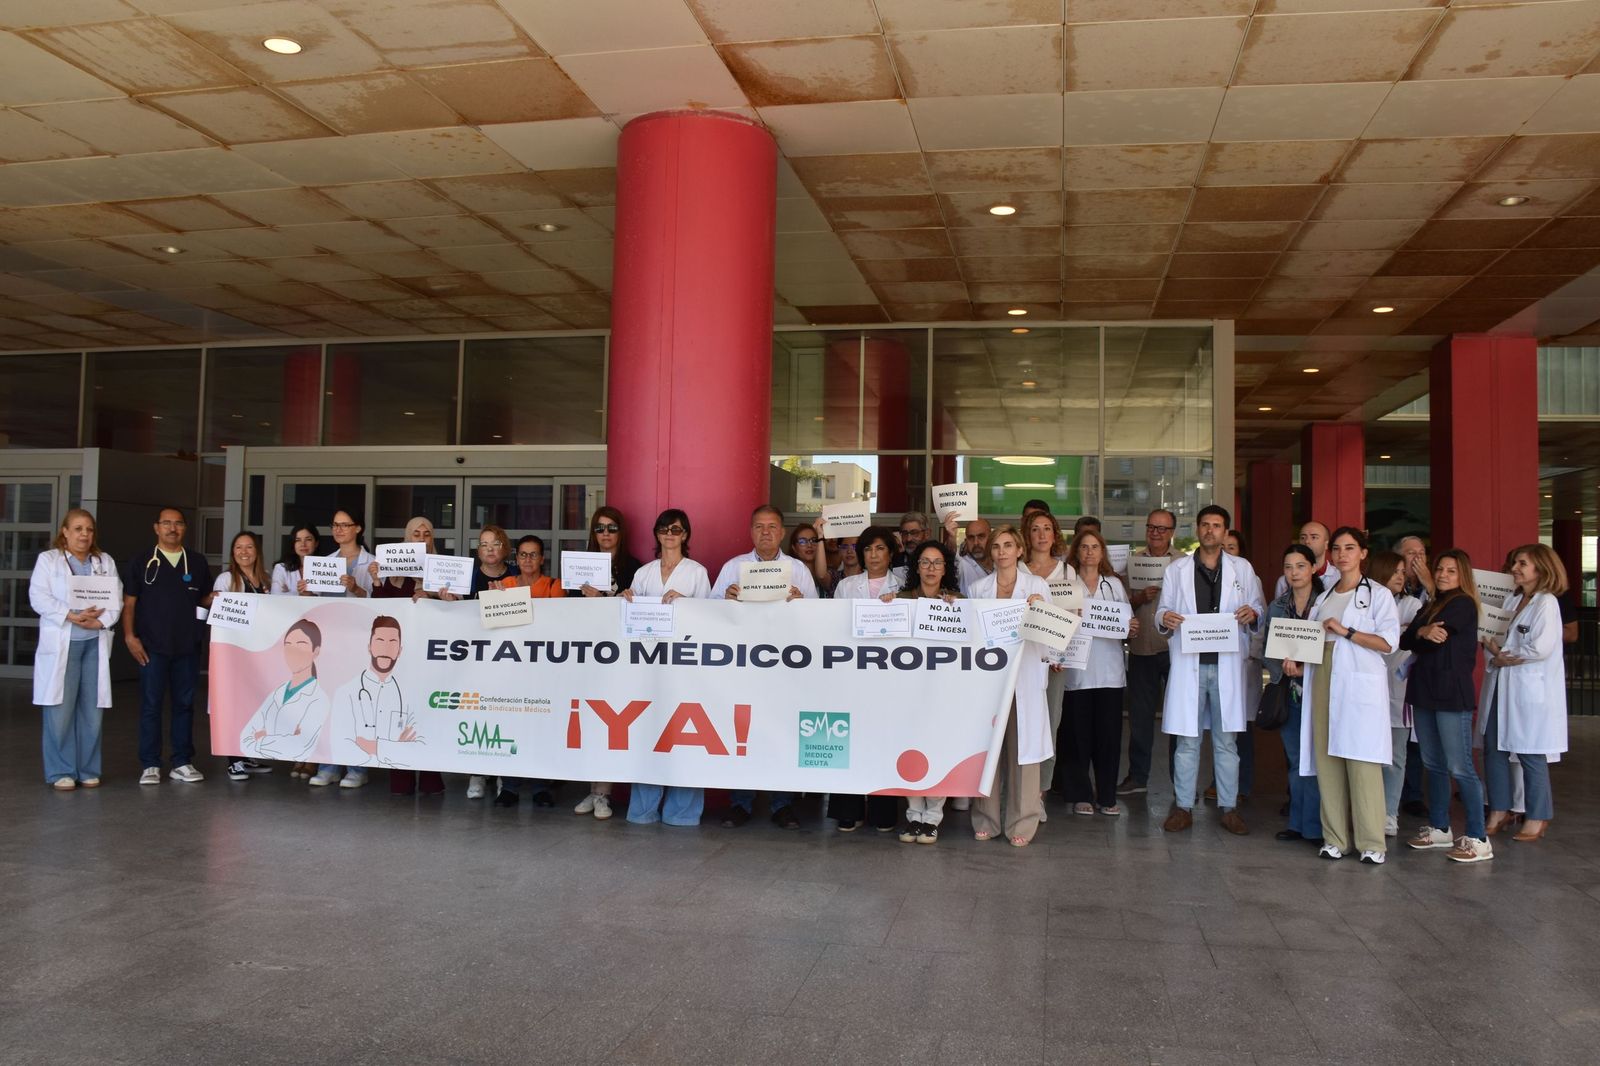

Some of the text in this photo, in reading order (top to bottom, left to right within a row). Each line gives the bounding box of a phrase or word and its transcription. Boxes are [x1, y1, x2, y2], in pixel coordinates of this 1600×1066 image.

[221, 606, 246, 615] TIRANÍA
[1004, 608, 1026, 616] QUIERO
[226, 616, 250, 625] INGESA
[928, 614, 961, 622] TIRANÍA
[992, 616, 1020, 626] OPERARTE
[1044, 610, 1072, 624] VOCACIÓN
[1090, 614, 1120, 622] TIRANÍA
[1098, 624, 1126, 632] INGESA
[426, 635, 1008, 672] ESTATUTO MÉDICO PROPIO
[428, 691, 480, 710] CESM
[480, 696, 522, 704] Confederación
[566, 699, 752, 756] ¡YA!
[800, 712, 848, 742] SMC
